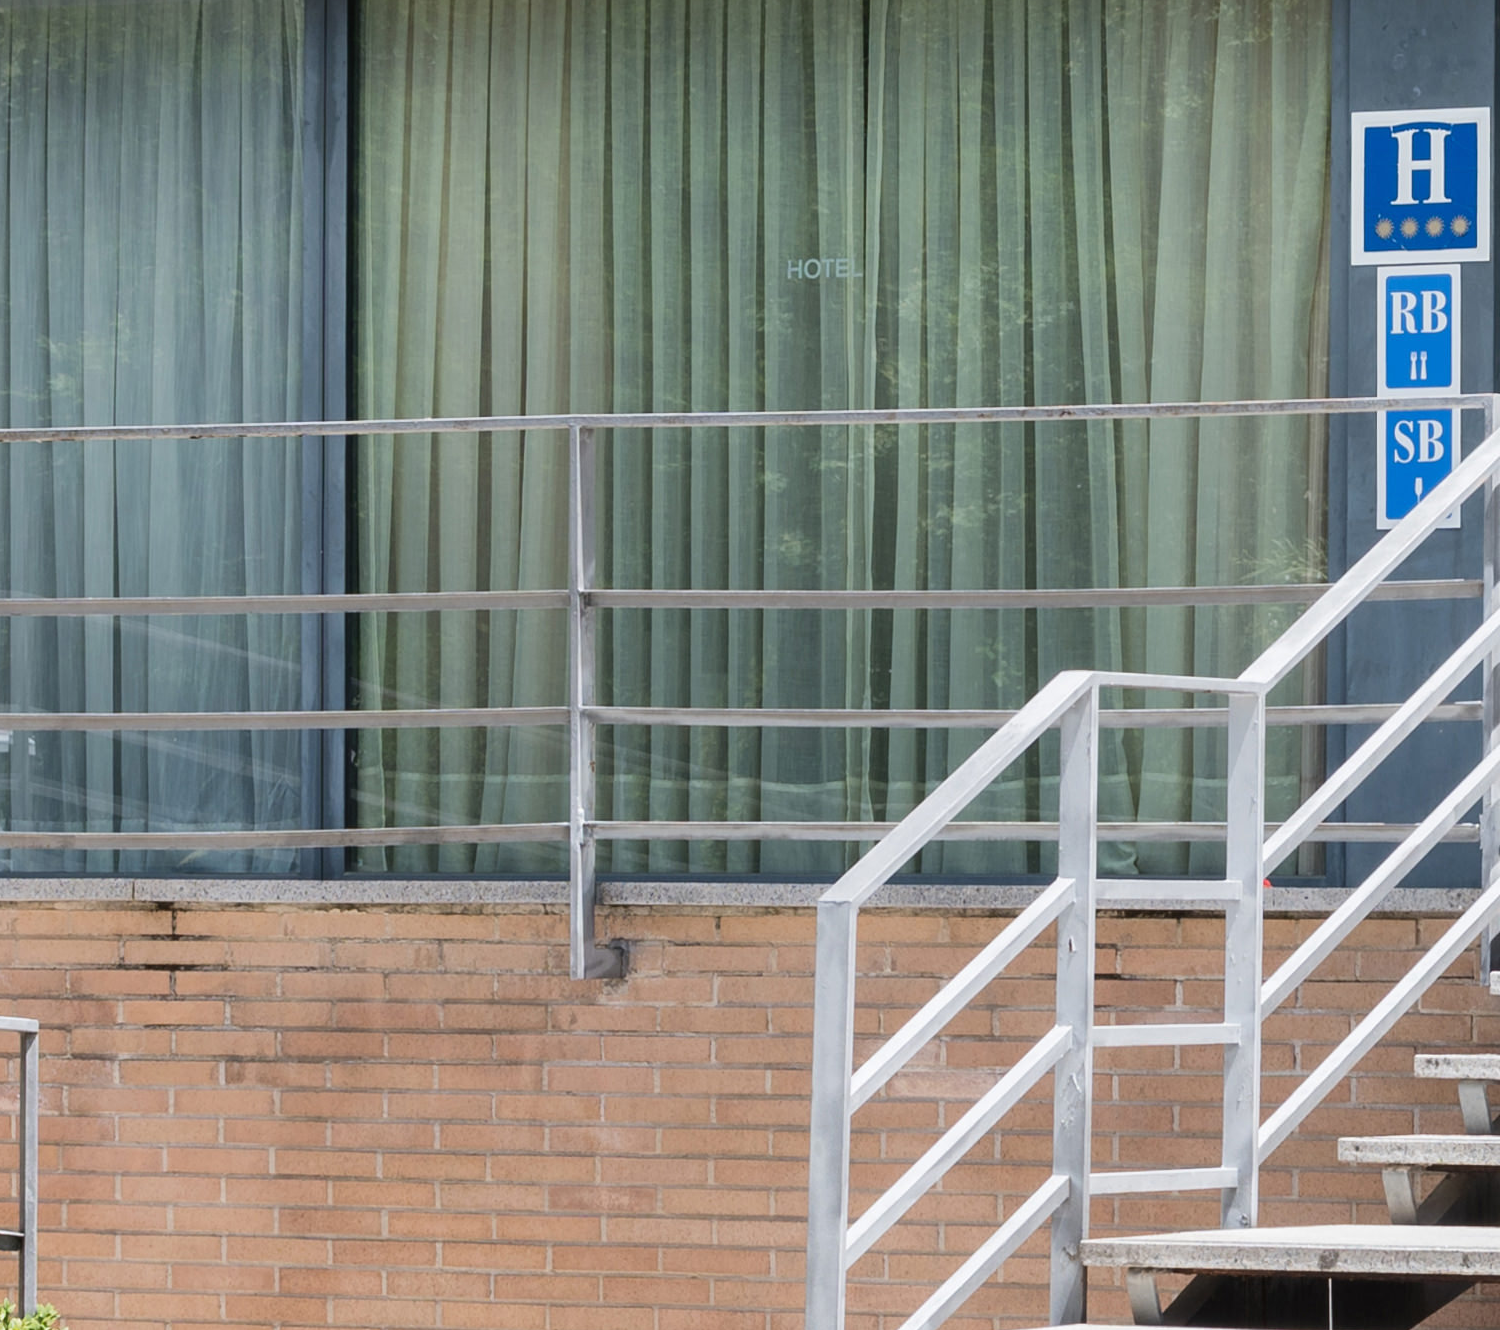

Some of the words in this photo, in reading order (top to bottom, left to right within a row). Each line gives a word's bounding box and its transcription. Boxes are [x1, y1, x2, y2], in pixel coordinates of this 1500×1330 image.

[1390, 127, 1452, 206] H
[786, 257, 864, 280] HOTEL
[1389, 289, 1449, 335] RB
[1393, 418, 1445, 464] SB
